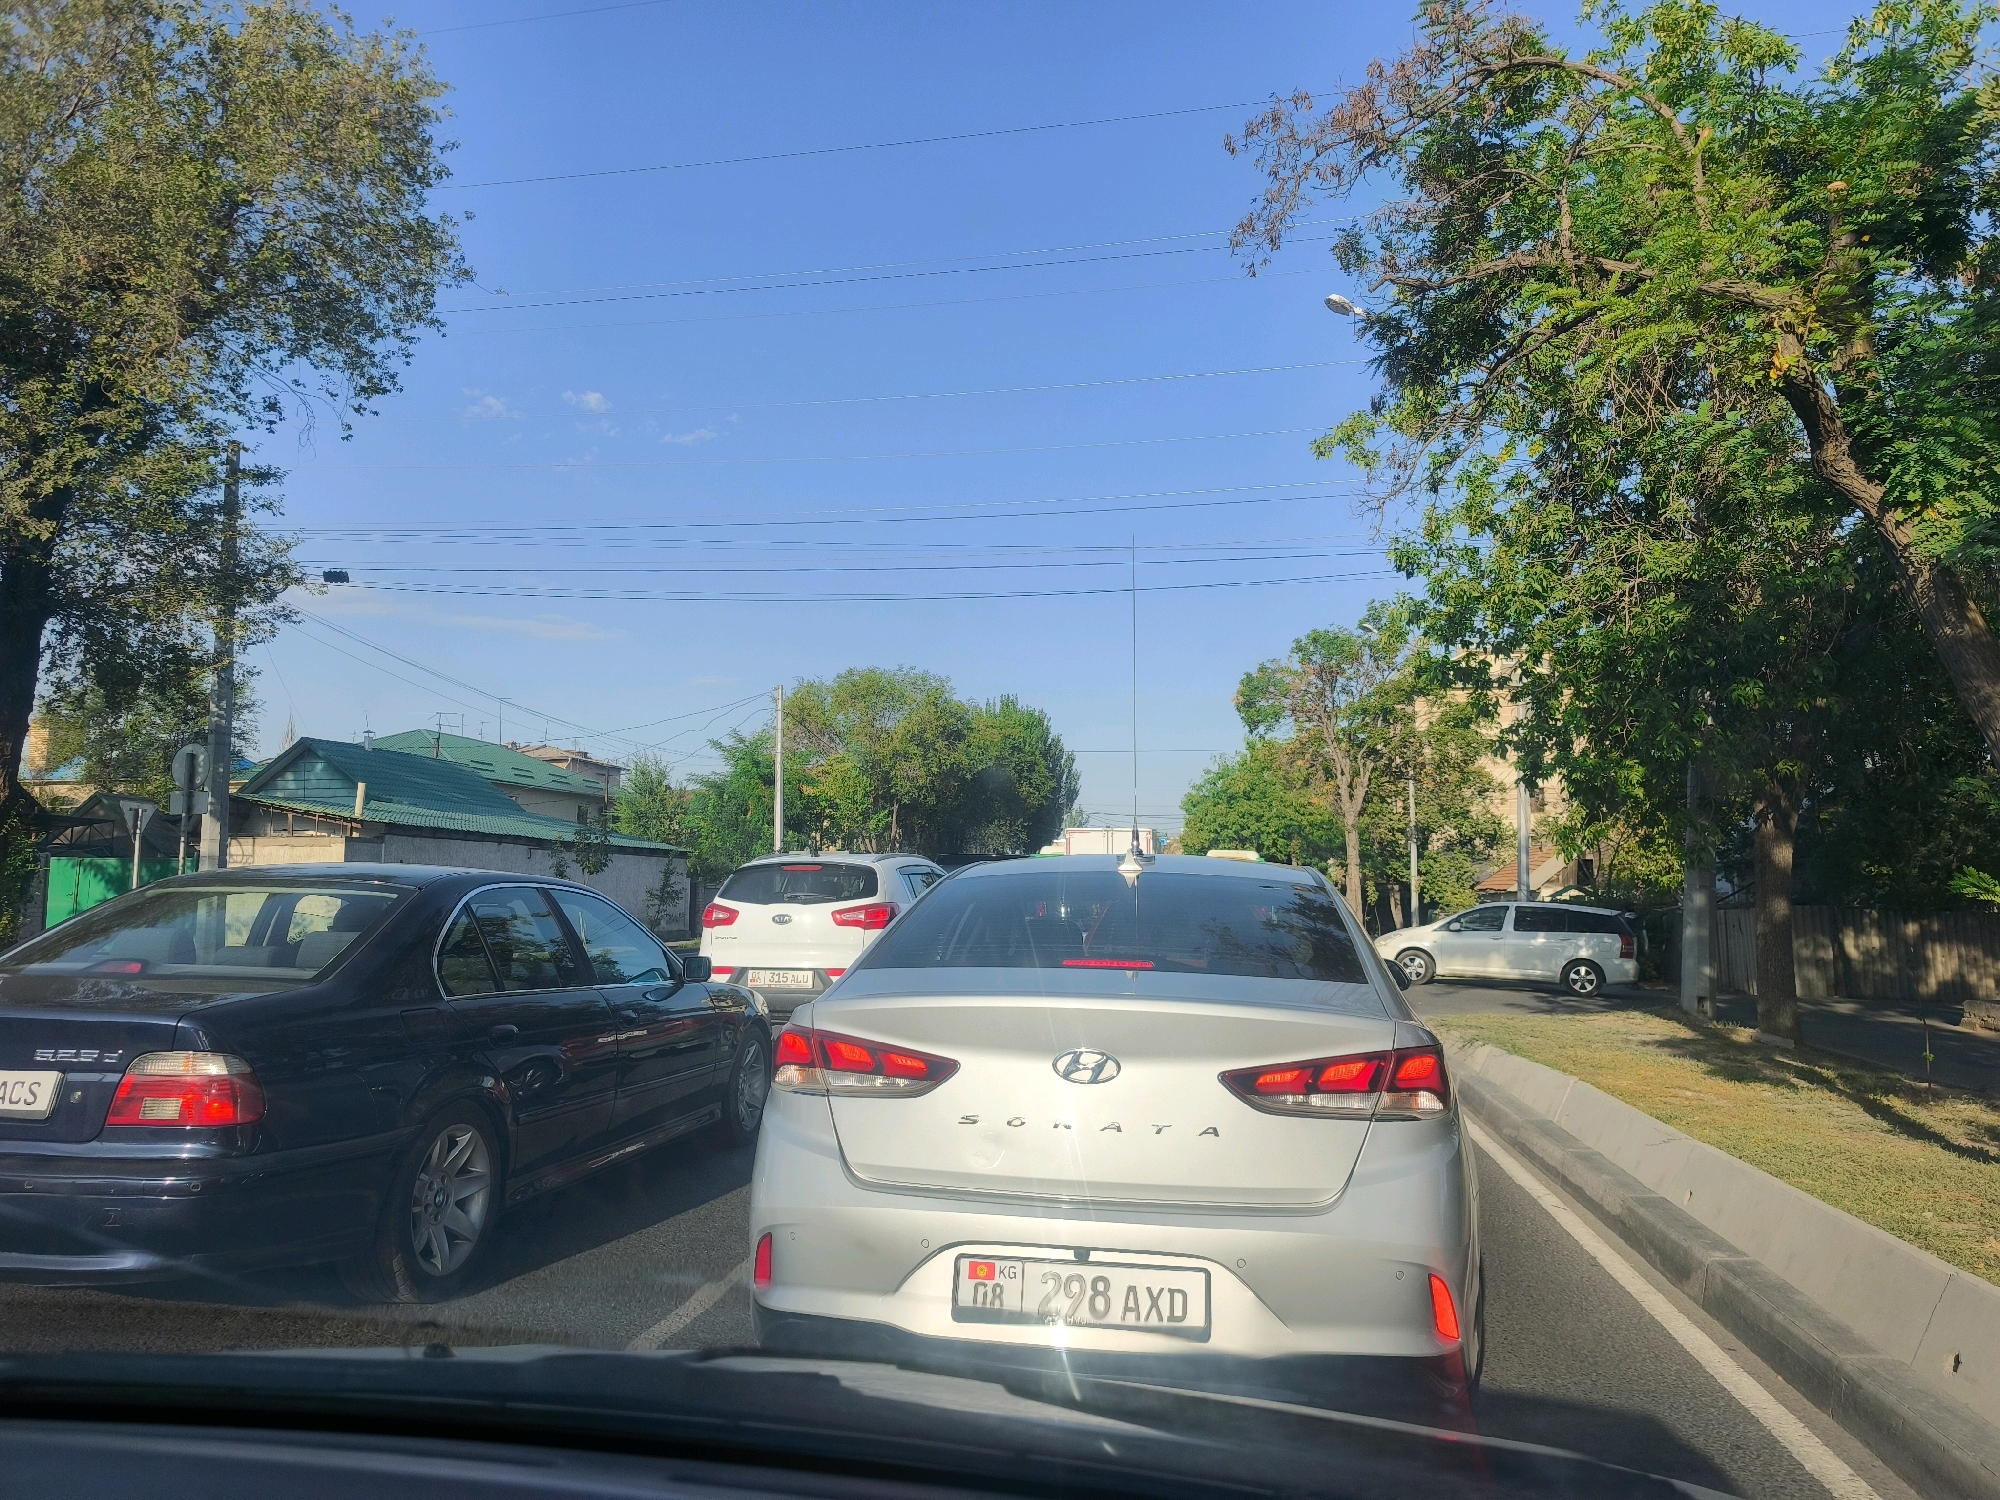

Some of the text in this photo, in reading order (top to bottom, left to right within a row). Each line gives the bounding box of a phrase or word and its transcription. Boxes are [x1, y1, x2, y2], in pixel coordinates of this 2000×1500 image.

[769, 972, 789, 984] 315
[791, 974, 809, 984] ALU
[957, 1113, 1220, 1138] SONATA
[998, 1265, 1017, 1280] KG
[1037, 1270, 1188, 1323] 298 AXD
